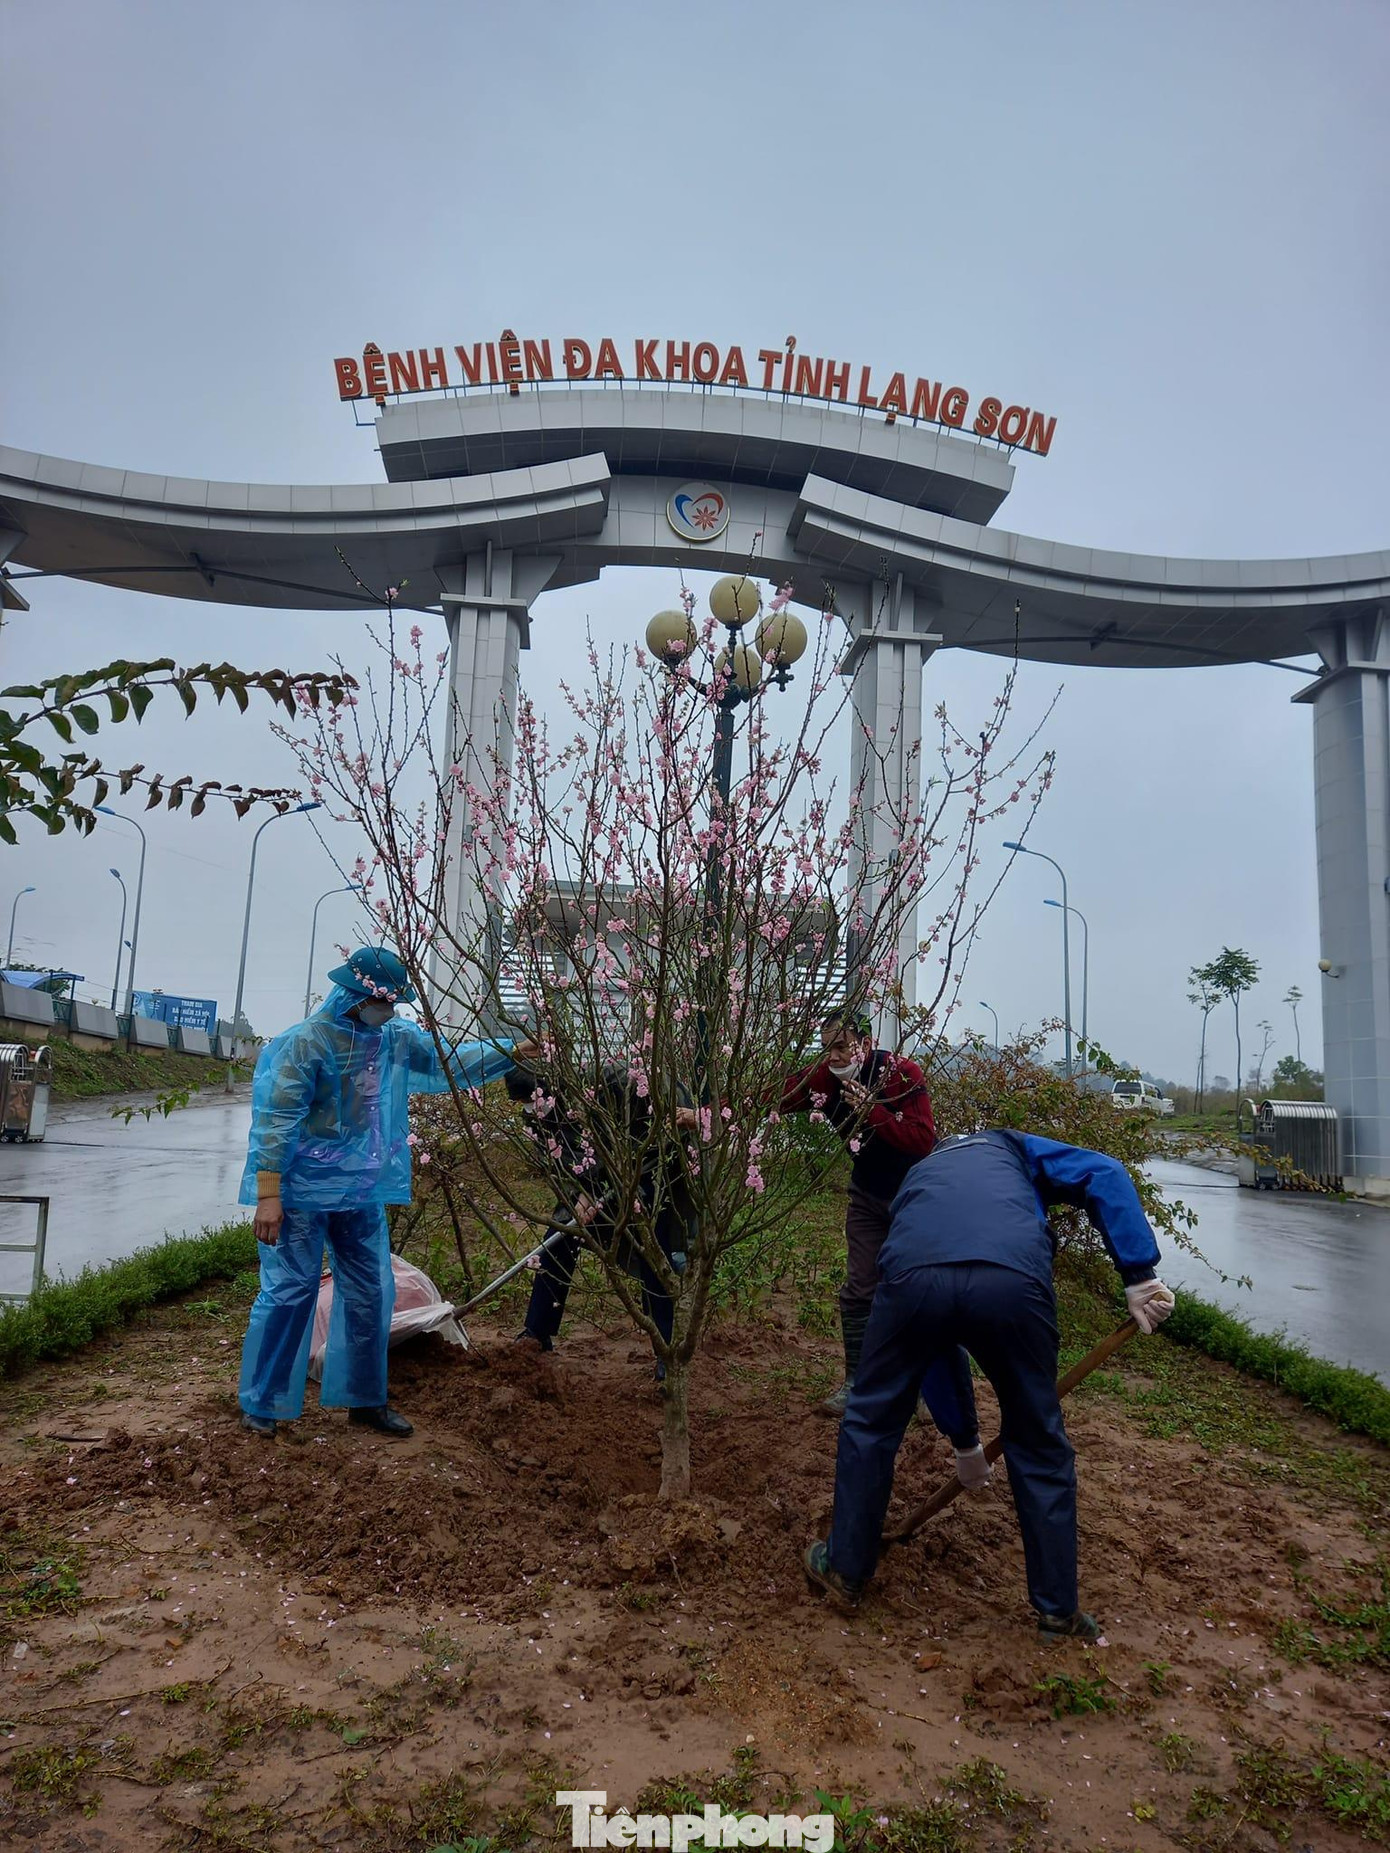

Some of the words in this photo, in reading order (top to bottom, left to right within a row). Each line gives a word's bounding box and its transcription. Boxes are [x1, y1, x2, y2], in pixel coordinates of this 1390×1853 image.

[333, 342, 449, 407] BỆNH
[454, 328, 554, 397] VIỆN
[562, 337, 625, 381] ĐA
[635, 339, 749, 388] KHOA
[758, 335, 852, 403] TỈNH
[857, 365, 969, 428] LẠNG
[974, 396, 1058, 457] SƠN
